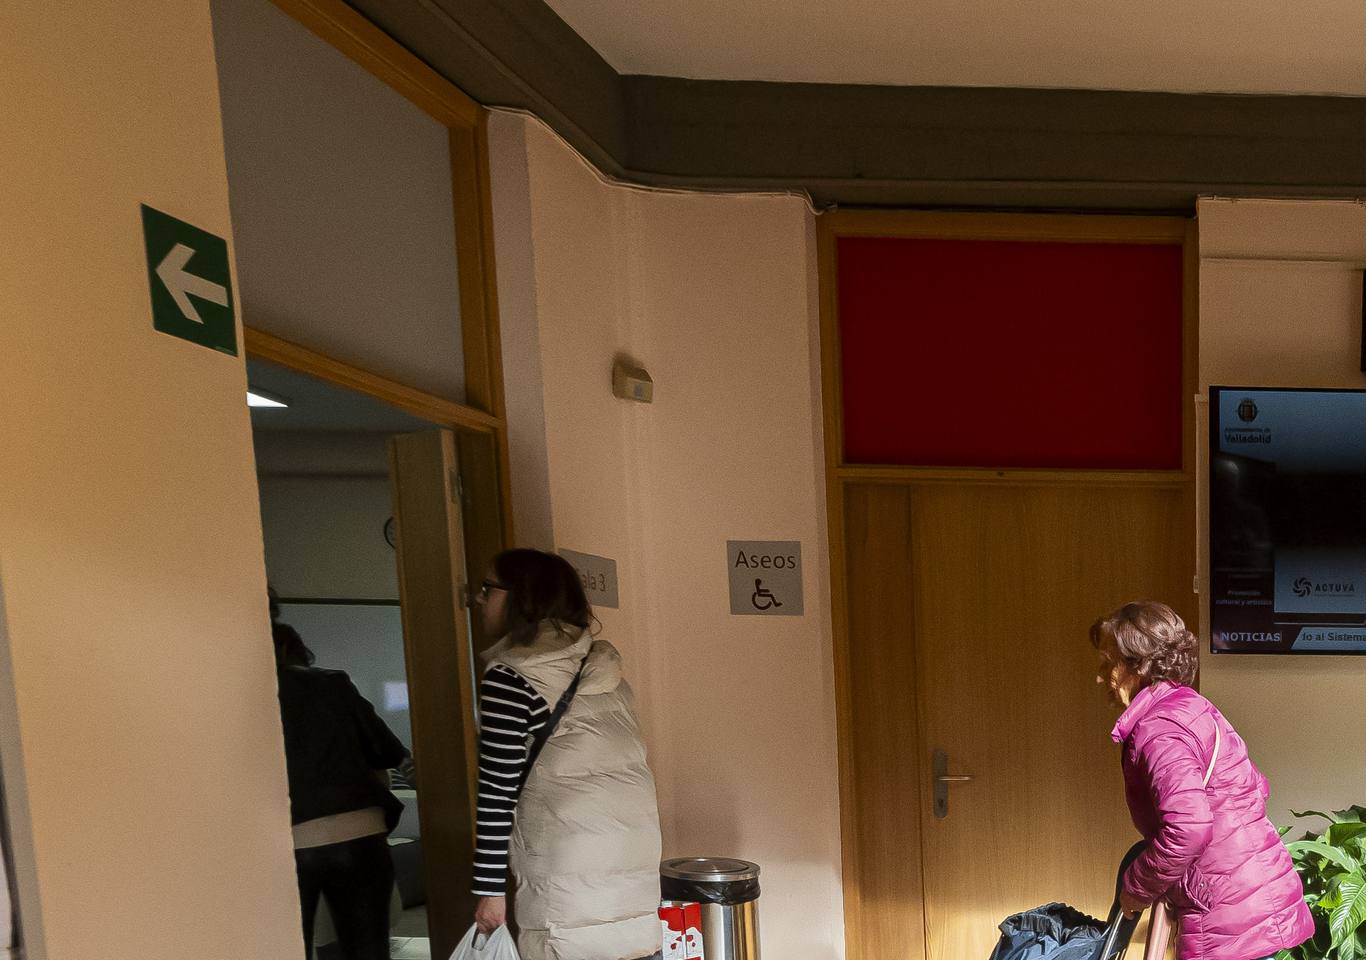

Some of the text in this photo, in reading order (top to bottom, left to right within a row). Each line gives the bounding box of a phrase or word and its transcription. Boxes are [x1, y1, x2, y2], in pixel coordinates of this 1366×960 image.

[735, 551, 796, 569] Aseos
[599, 573, 607, 592] 3
[1315, 583, 1356, 592] ACTUVA
[1220, 631, 1281, 643] NOTICIAS
